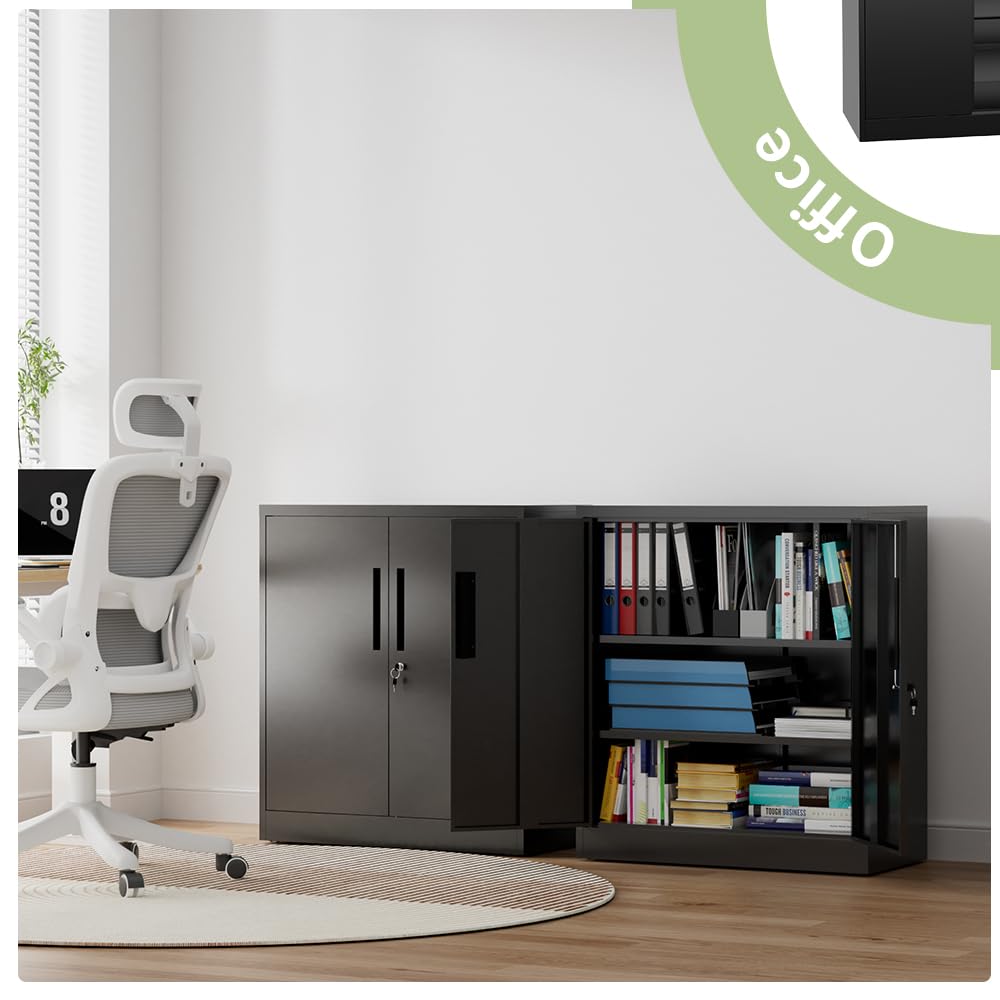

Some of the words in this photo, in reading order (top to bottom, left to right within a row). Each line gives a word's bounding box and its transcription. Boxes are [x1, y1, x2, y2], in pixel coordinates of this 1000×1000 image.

[50, 491, 70, 526] 8
[765, 807, 782, 816] TOUGH
[782, 807, 807, 817] BUSINESS
